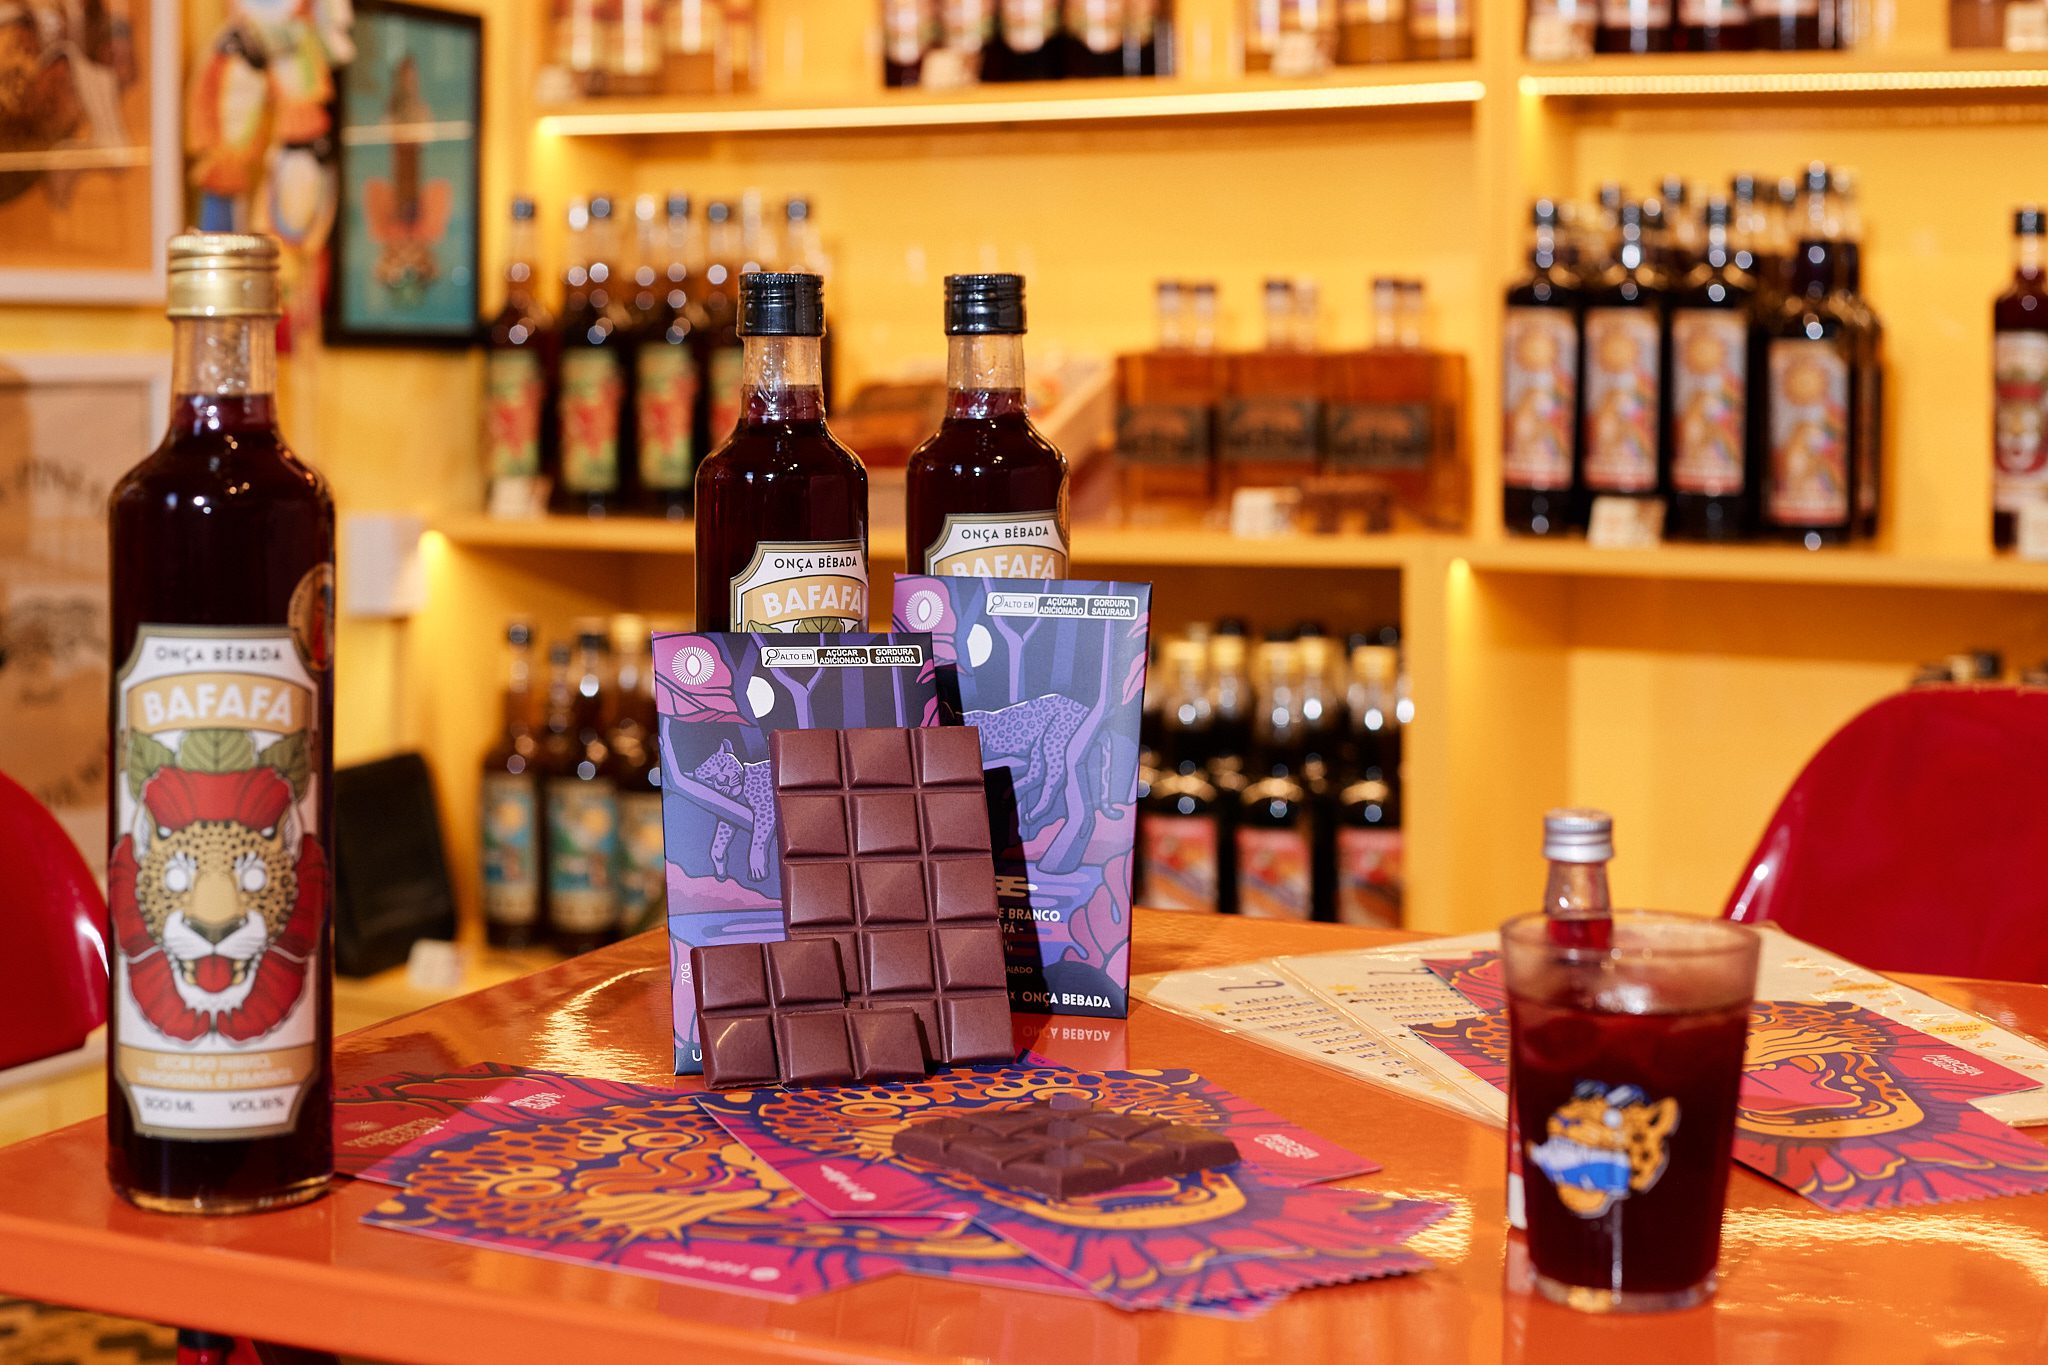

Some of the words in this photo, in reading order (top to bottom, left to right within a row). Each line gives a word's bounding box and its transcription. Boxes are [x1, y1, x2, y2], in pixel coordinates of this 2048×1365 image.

[961, 529, 999, 542] ONÇA
[1005, 525, 1049, 539] BÊBADA
[774, 558, 813, 572] ONÇA
[818, 555, 858, 568] BÊBADA
[762, 585, 862, 618] BAFAFÁ
[1046, 597, 1077, 607] AÇÚCAR
[1094, 599, 1130, 607] GORDURA
[1039, 606, 1084, 615] ADICIONADO
[1091, 607, 1131, 616] SATURADA
[155, 646, 204, 665] ONÇA
[213, 645, 282, 661] BÊBADA
[826, 648, 858, 658] AÇÚCAR
[876, 648, 914, 656] GORDURA
[820, 656, 867, 664] ADICIONADO
[875, 656, 916, 664] SATURADA
[142, 683, 294, 727] BAFAFÁ
[1008, 908, 1061, 921] BRANCO
[681, 963, 691, 985] 70G
[1022, 991, 1058, 1006] ONÇA
[1062, 993, 1111, 1008] BEBADA
